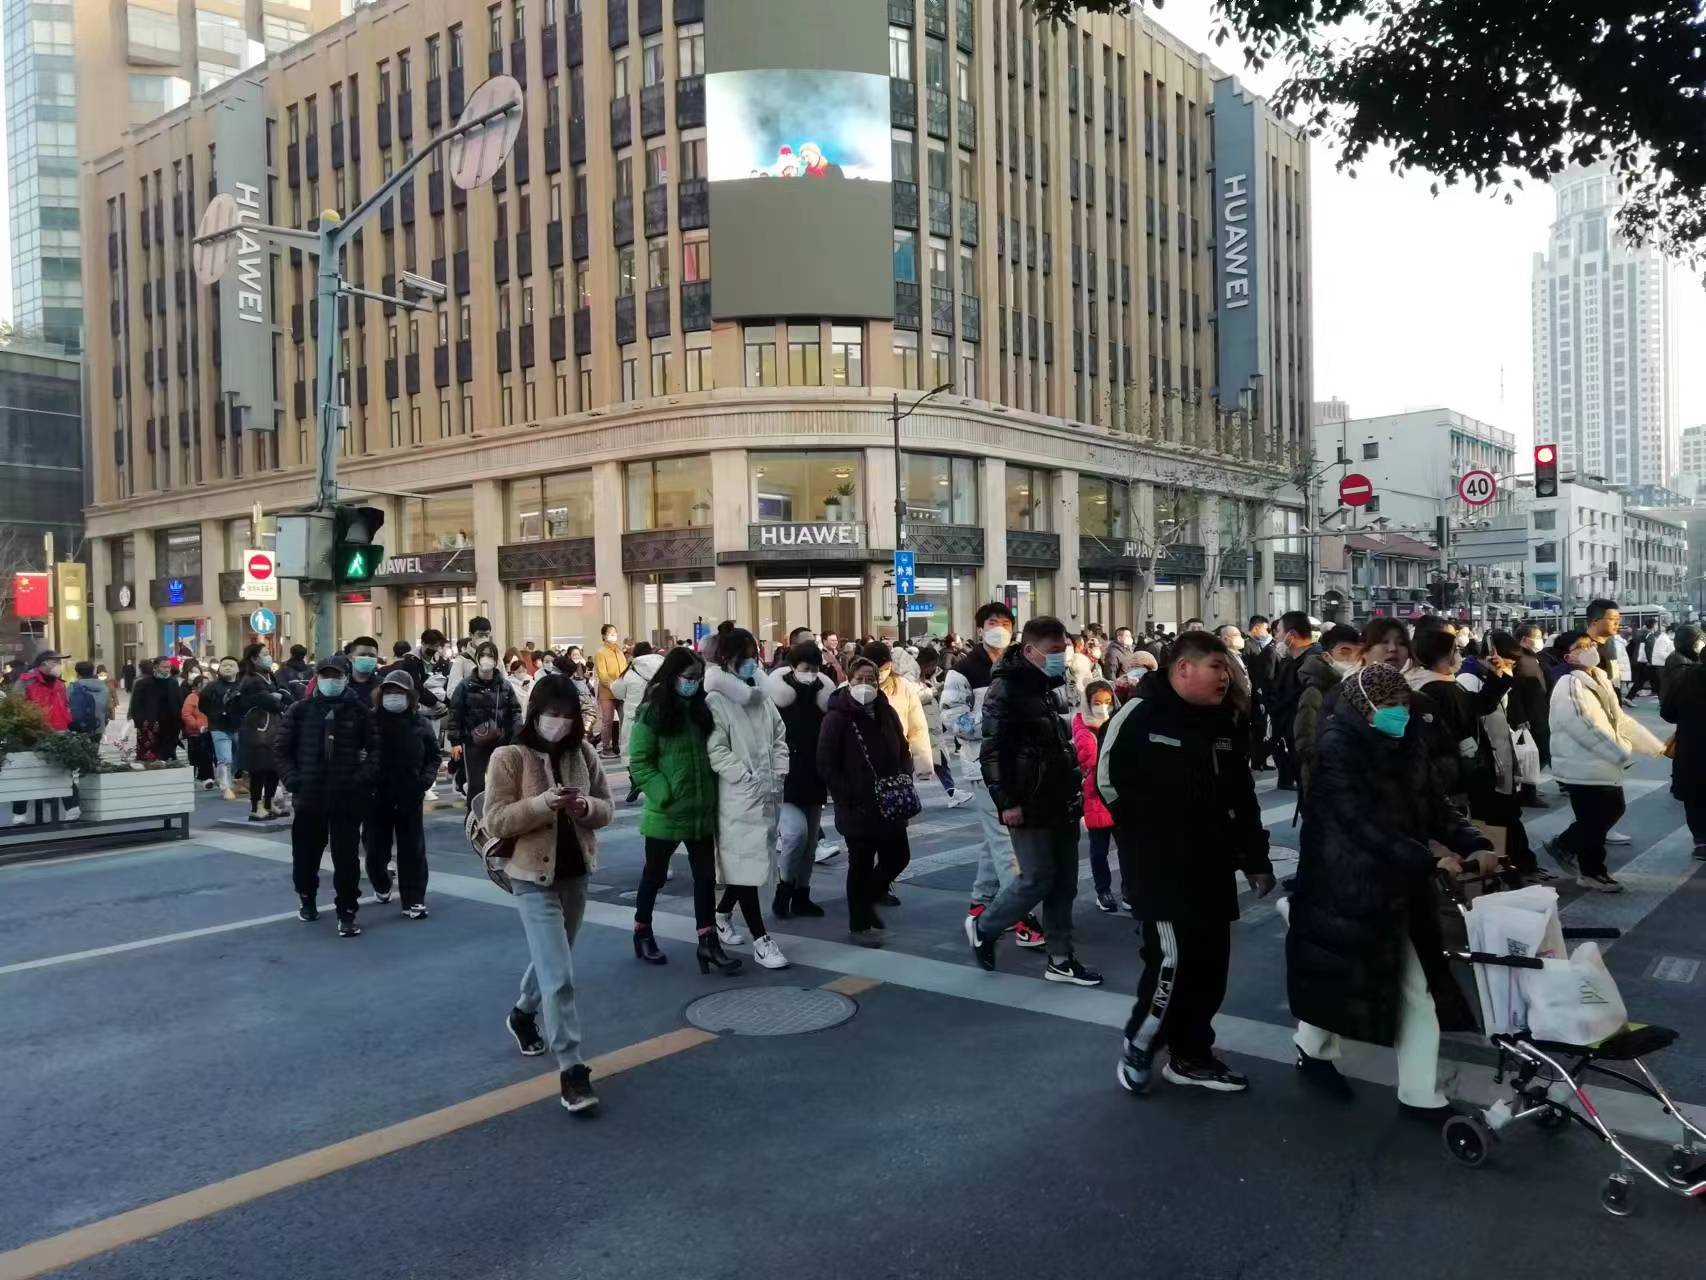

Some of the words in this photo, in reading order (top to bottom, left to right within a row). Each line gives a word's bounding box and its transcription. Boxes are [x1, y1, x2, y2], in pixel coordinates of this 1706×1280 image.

[1224, 174, 1249, 309] HUAWEI
[235, 181, 263, 323] HUAWEI
[1467, 478, 1489, 496] 40
[761, 526, 860, 545] HUAWEI
[375, 557, 421, 577] UAWEI
